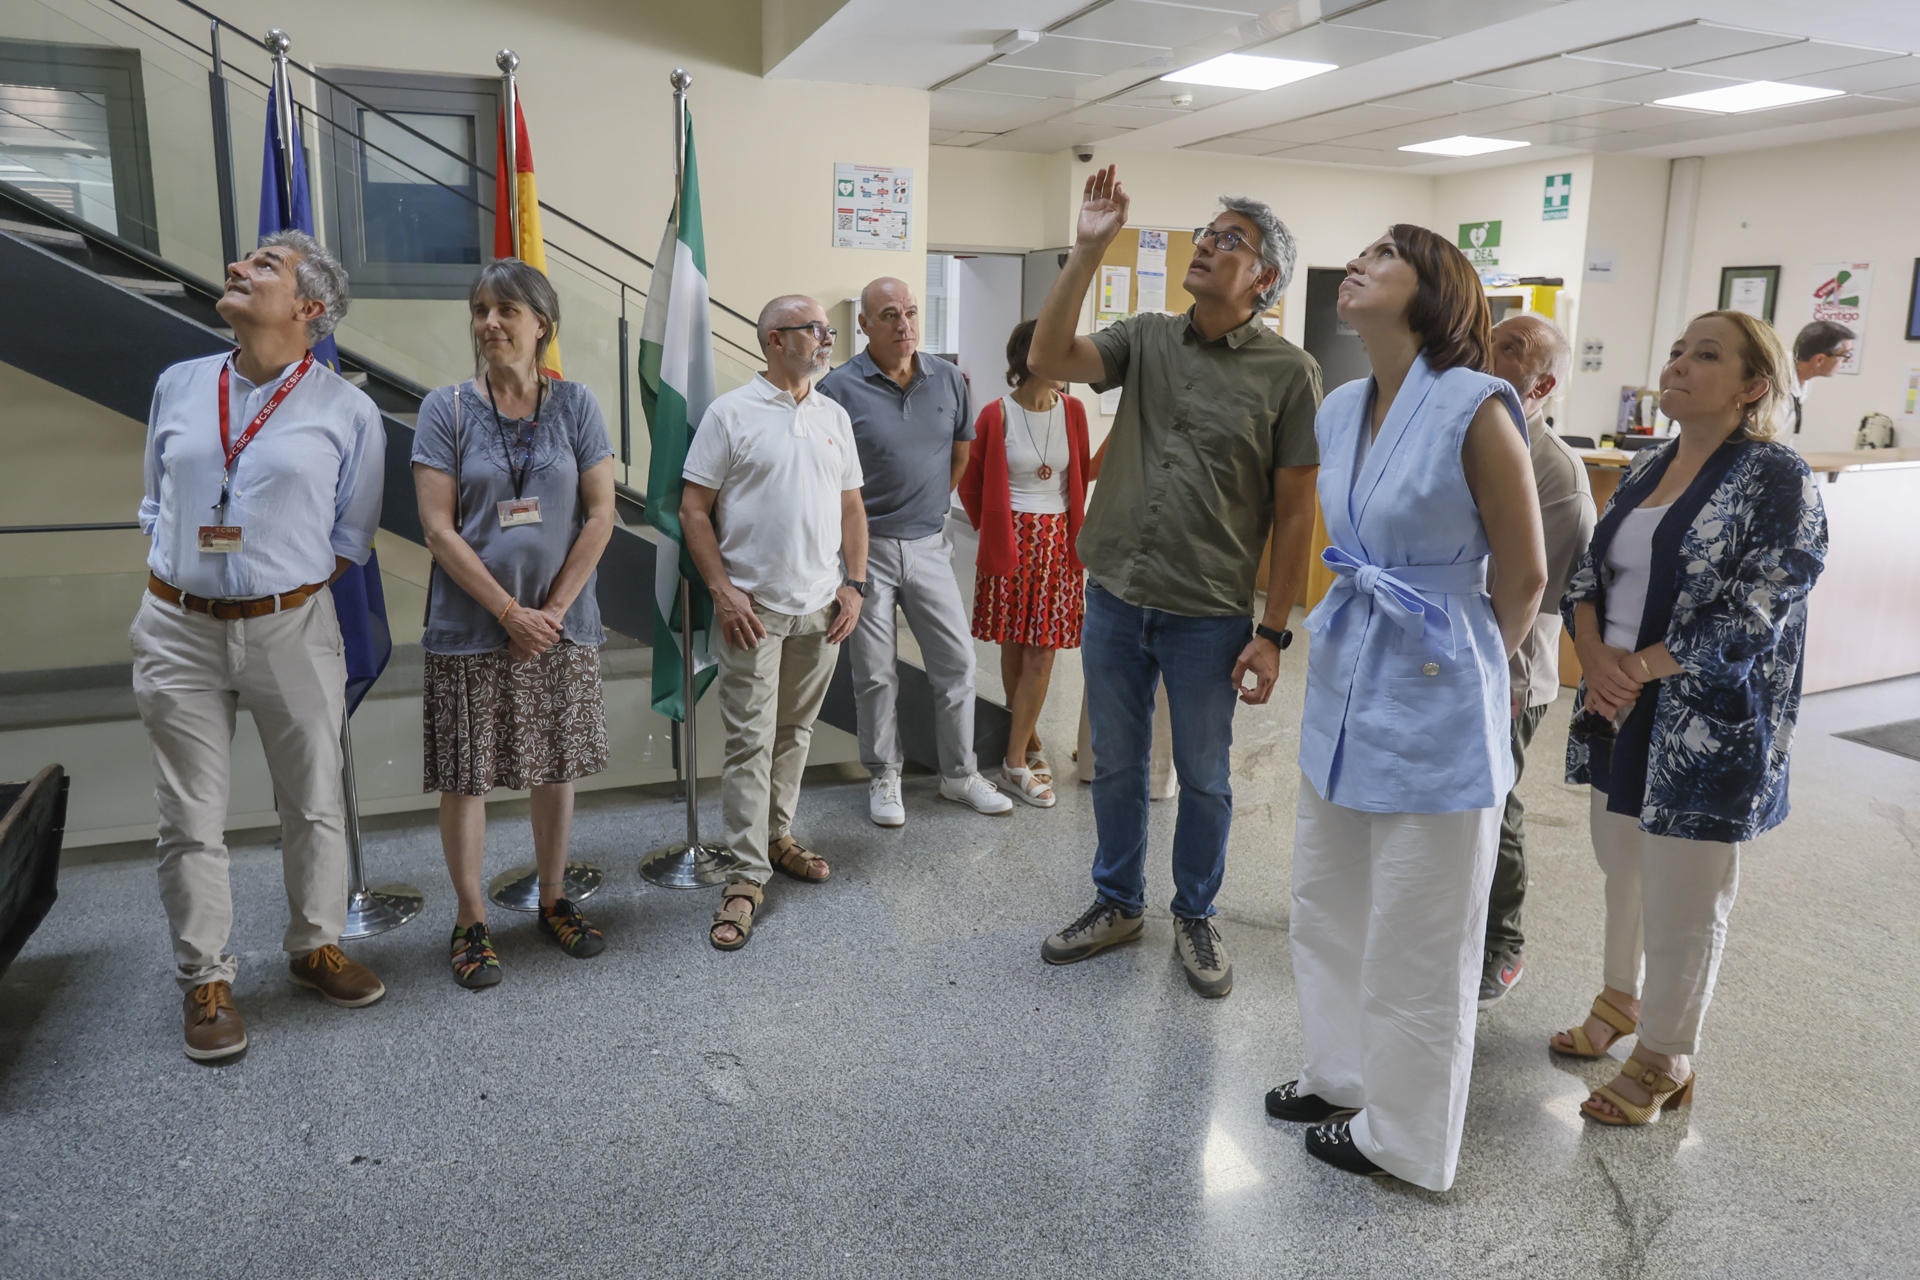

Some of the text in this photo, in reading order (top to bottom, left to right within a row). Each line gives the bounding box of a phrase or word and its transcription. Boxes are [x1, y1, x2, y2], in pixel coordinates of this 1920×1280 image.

[1474, 248, 1494, 260] DEA
[285, 370, 303, 389] CSIC
[259, 399, 278, 420] CSIC
[231, 433, 251, 455] CSIC
